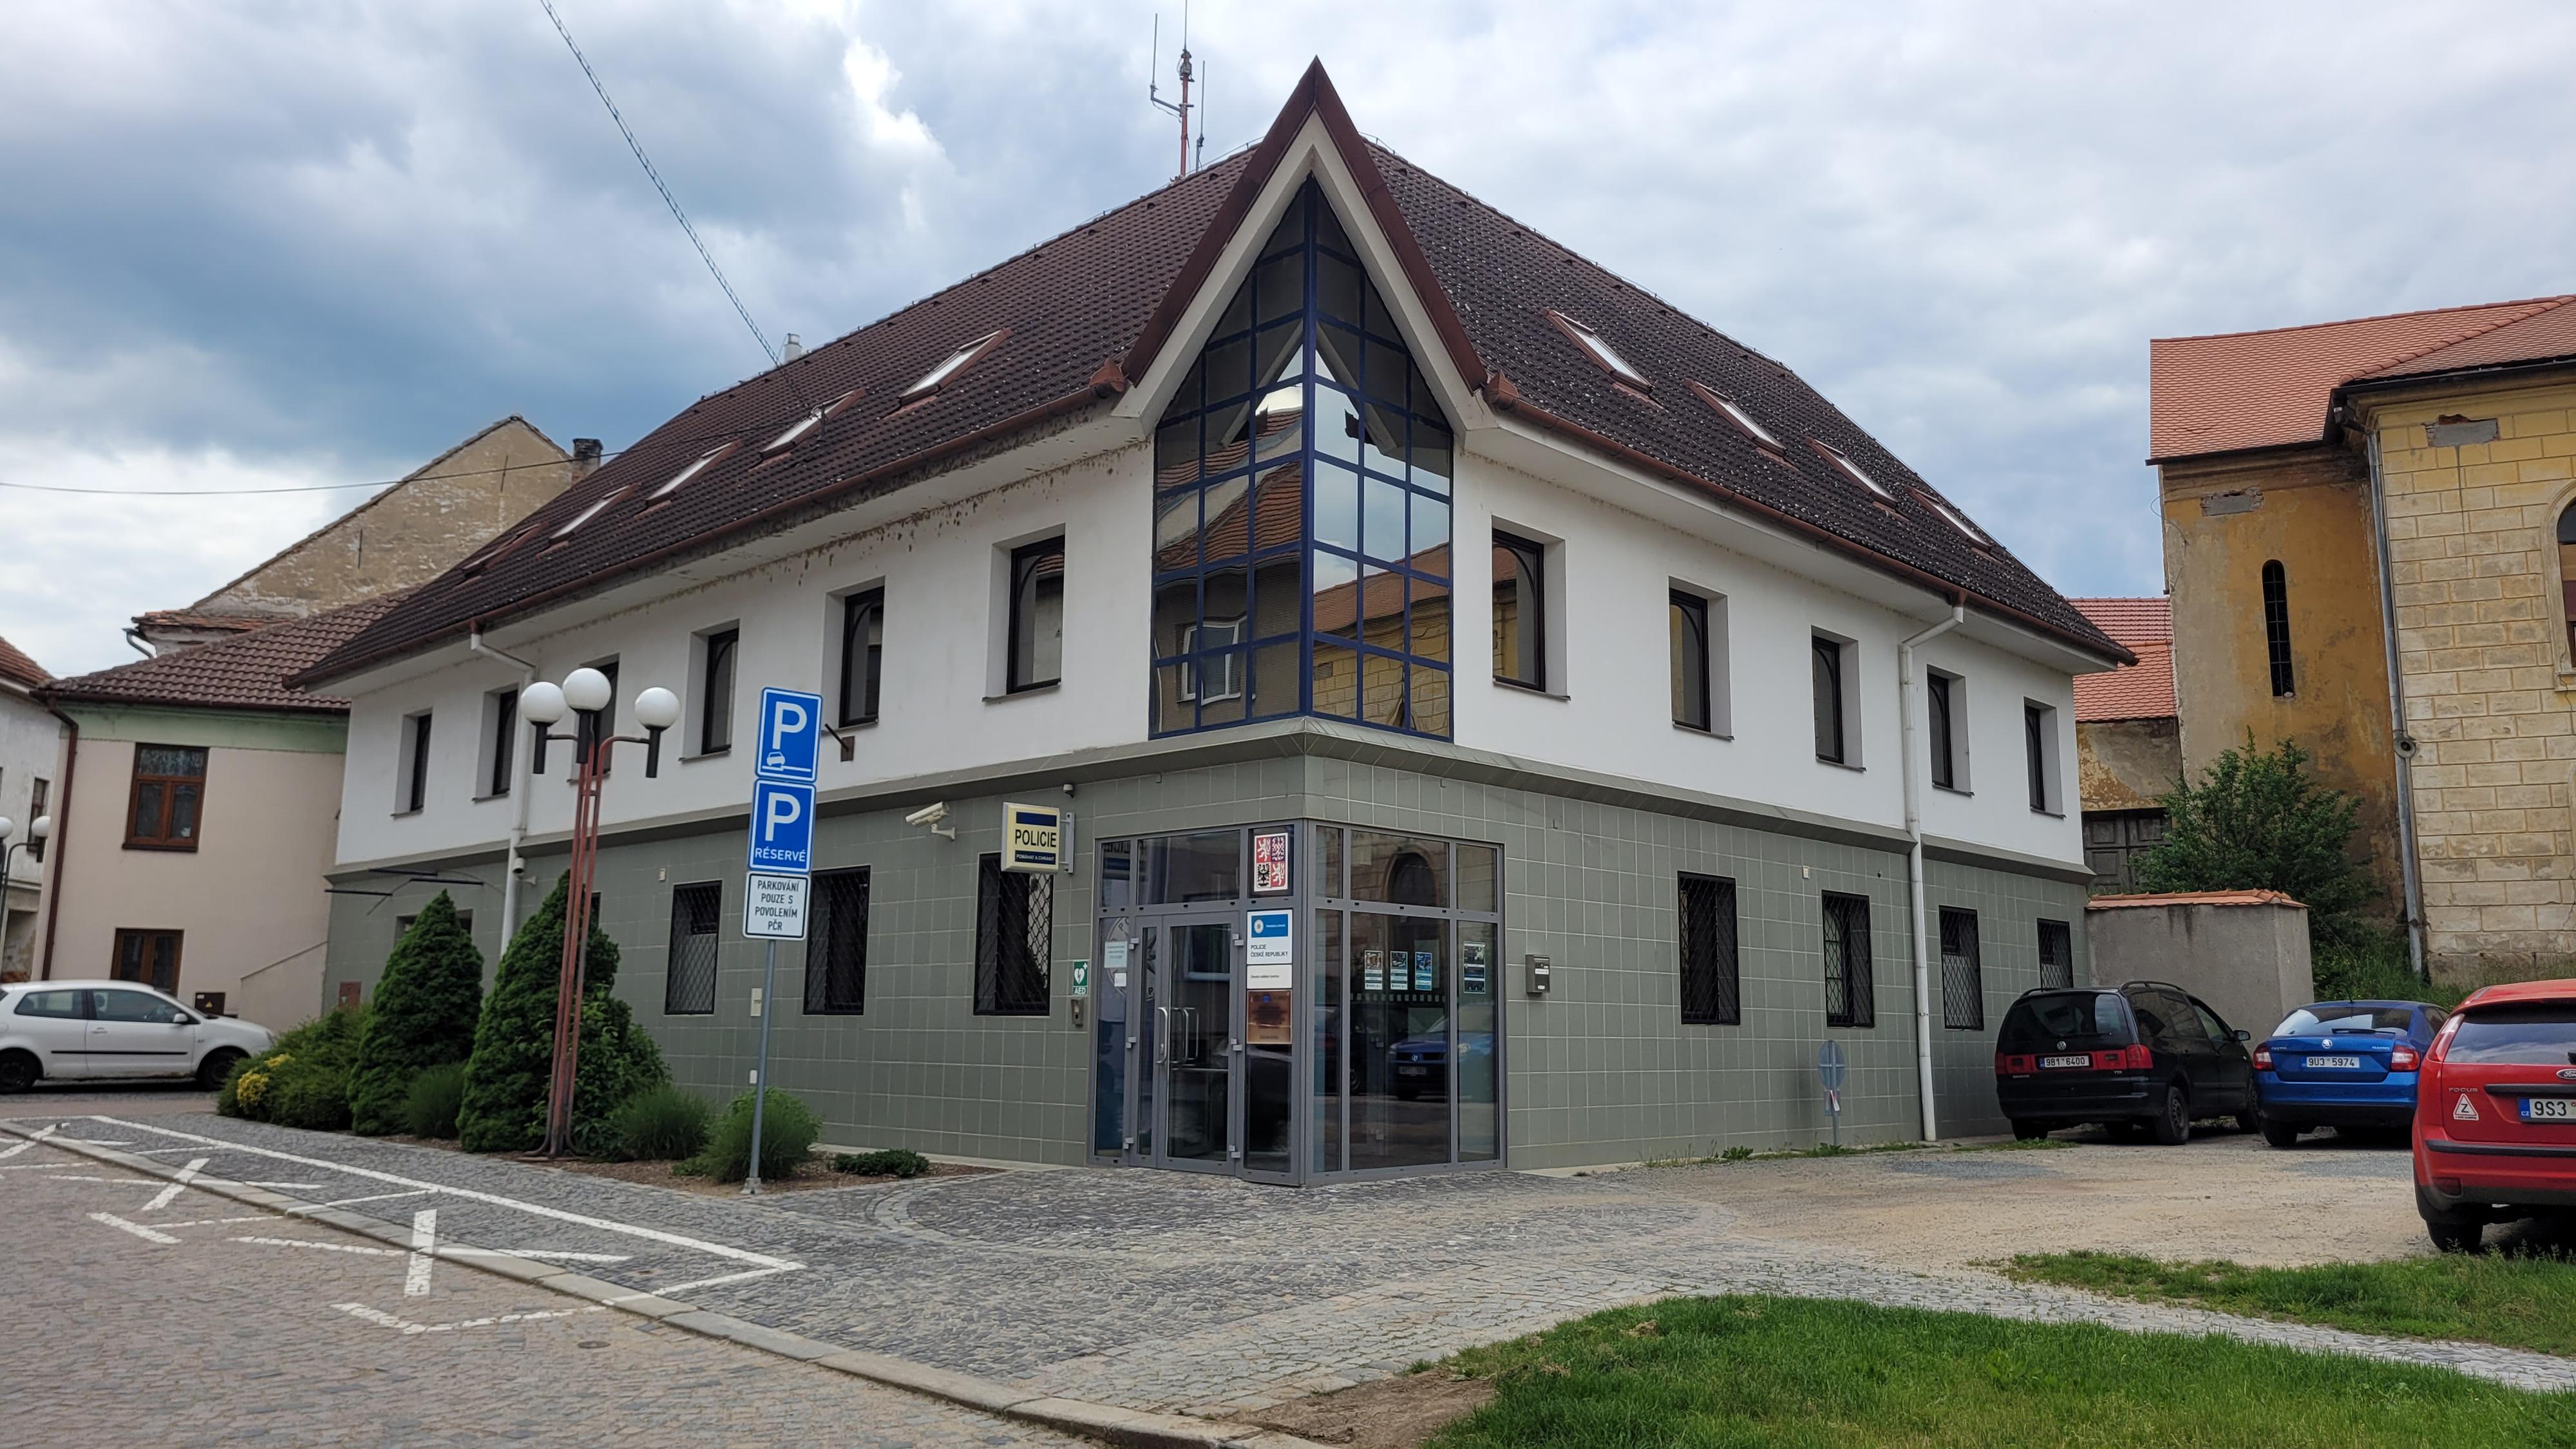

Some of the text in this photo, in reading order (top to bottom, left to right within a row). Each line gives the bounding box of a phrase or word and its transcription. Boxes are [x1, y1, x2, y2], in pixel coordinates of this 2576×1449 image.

[773, 701, 807, 750] P
[764, 792, 800, 841] P
[1015, 829, 1056, 848] POLICIE
[755, 846, 806, 862] RÉSERVÉ
[757, 880, 799, 892] PARKOVÁNÍ
[761, 893, 793, 904] POUZE S
[755, 906, 798, 918] POVOLENÍM
[768, 919, 782, 931] PČR
[2332, 1058, 2354, 1066] 5974
[2461, 1103, 2469, 1113] Z
[2534, 1101, 2567, 1116] 9S3
